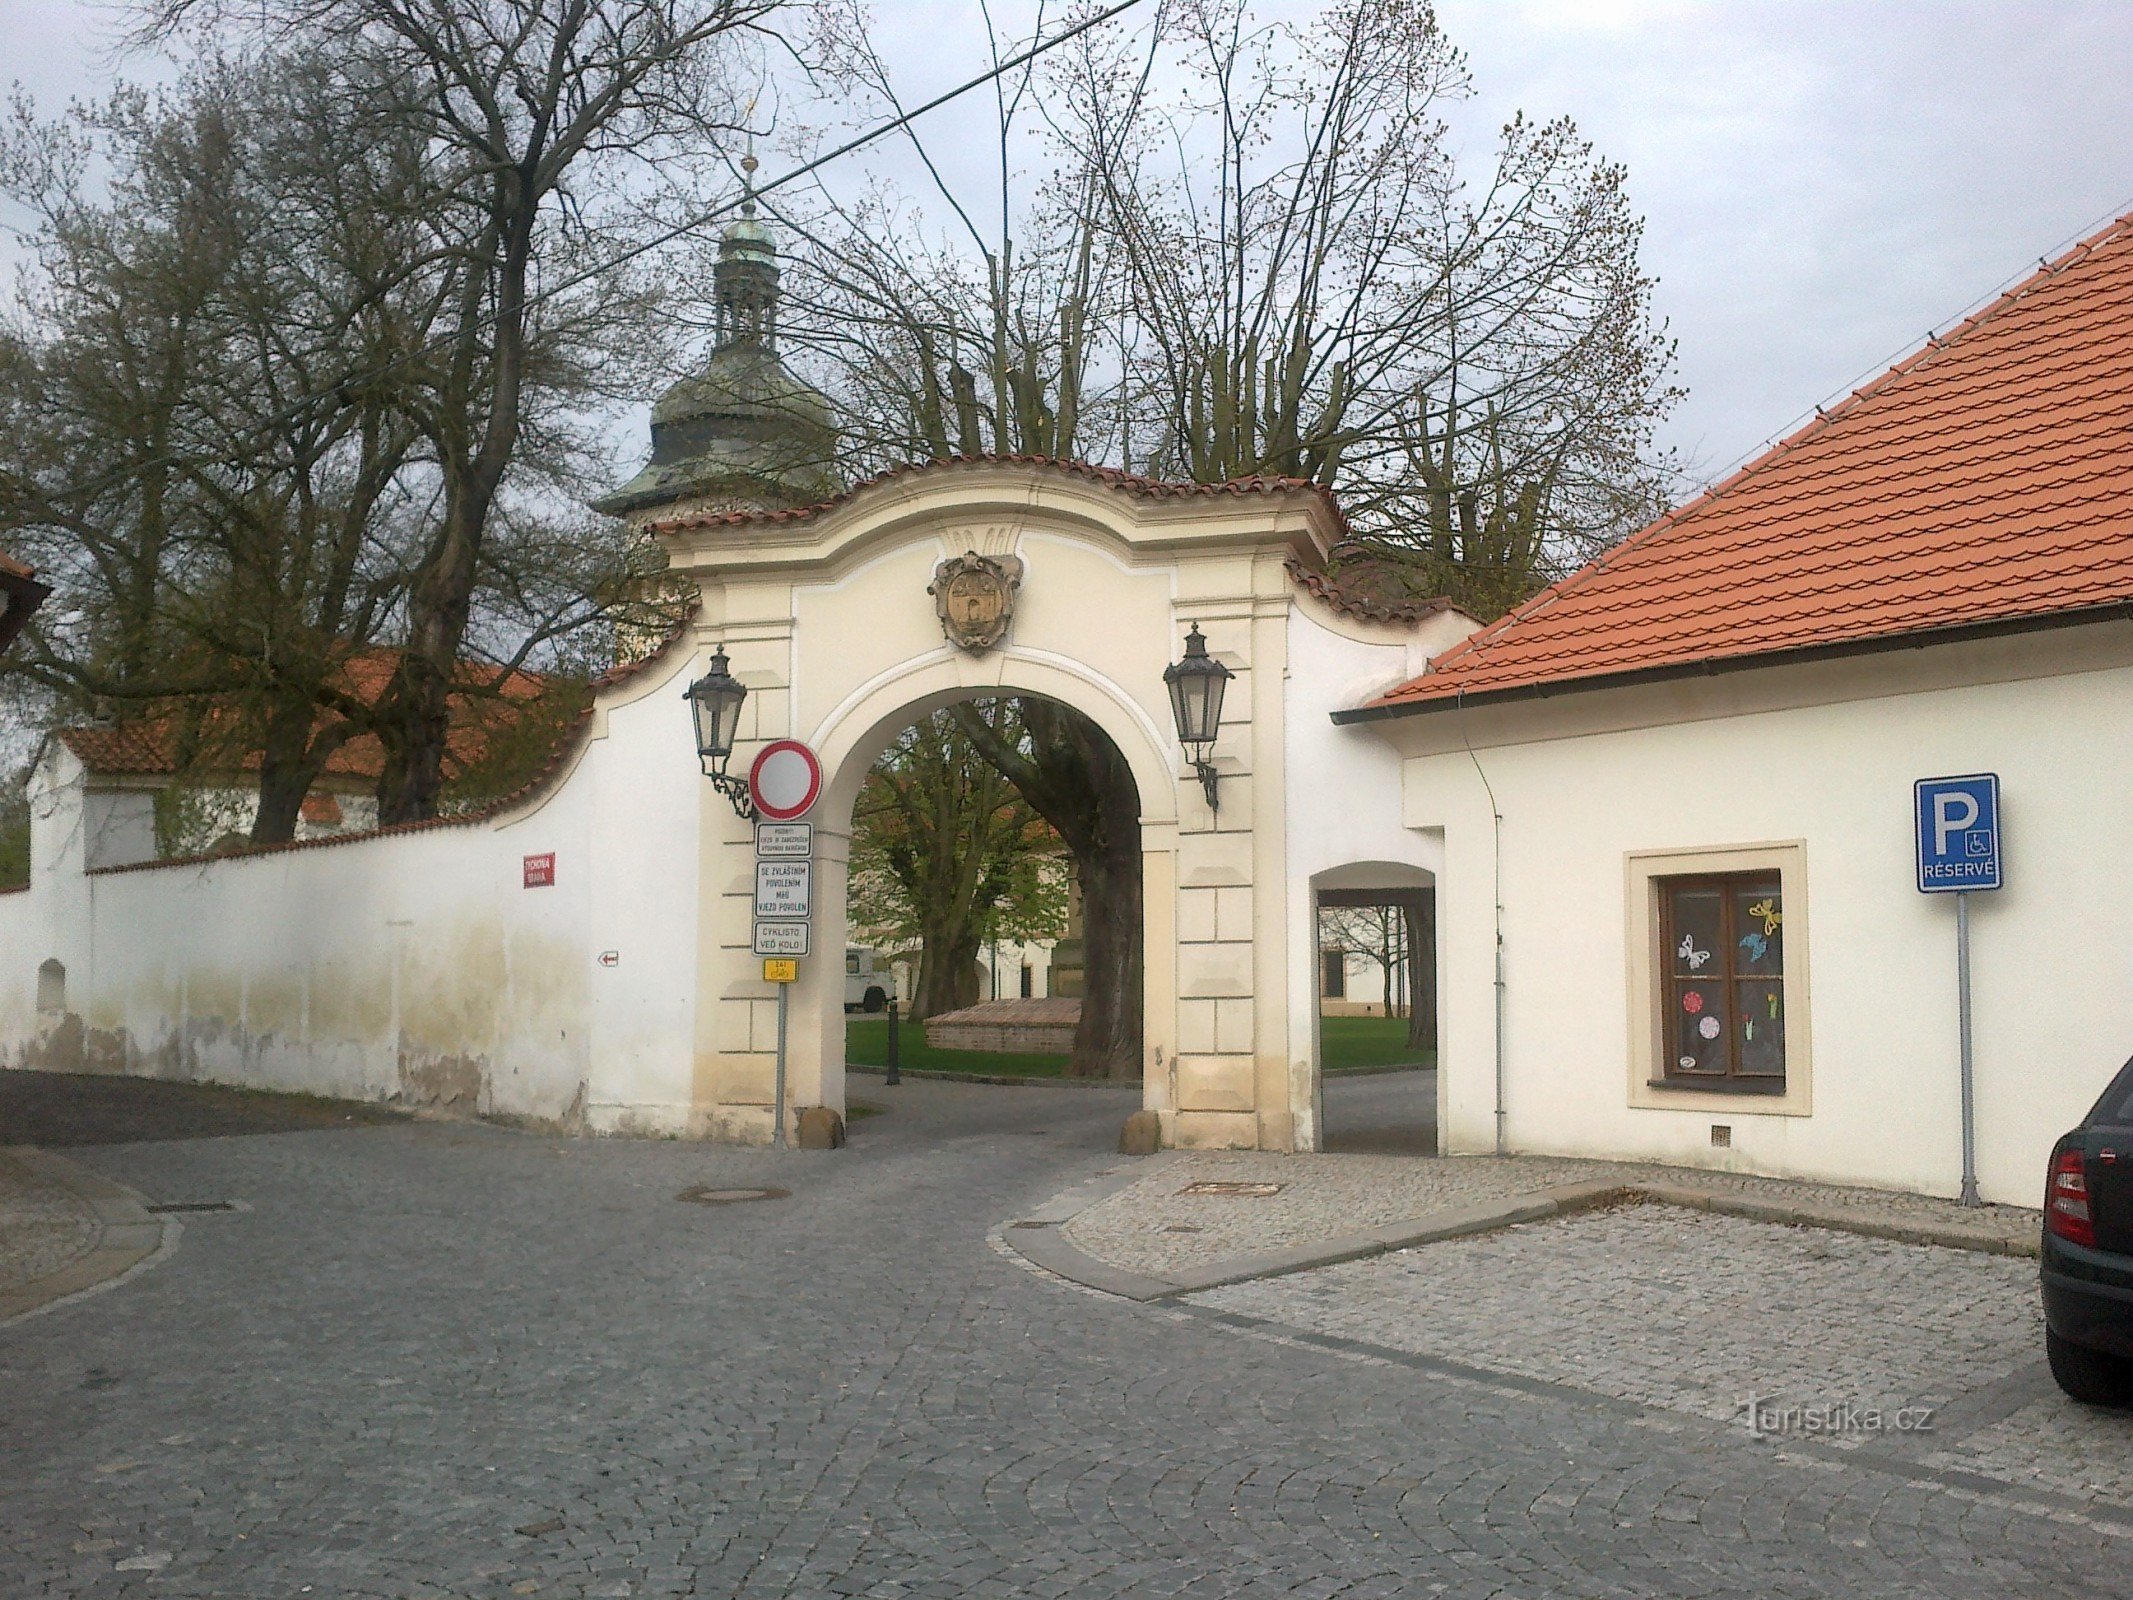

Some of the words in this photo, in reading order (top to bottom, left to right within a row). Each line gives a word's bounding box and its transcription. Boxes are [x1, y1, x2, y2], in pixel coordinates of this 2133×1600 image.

[1934, 791, 1979, 855] P
[761, 867, 769, 876] SE
[771, 865, 806, 876] ZVLÁŠTNÍM
[1925, 858, 1995, 878] RÉSERVÉ
[766, 878, 801, 888] POVOLENÍM
[759, 902, 777, 911] VJEZD
[779, 902, 807, 911] POVOLEN
